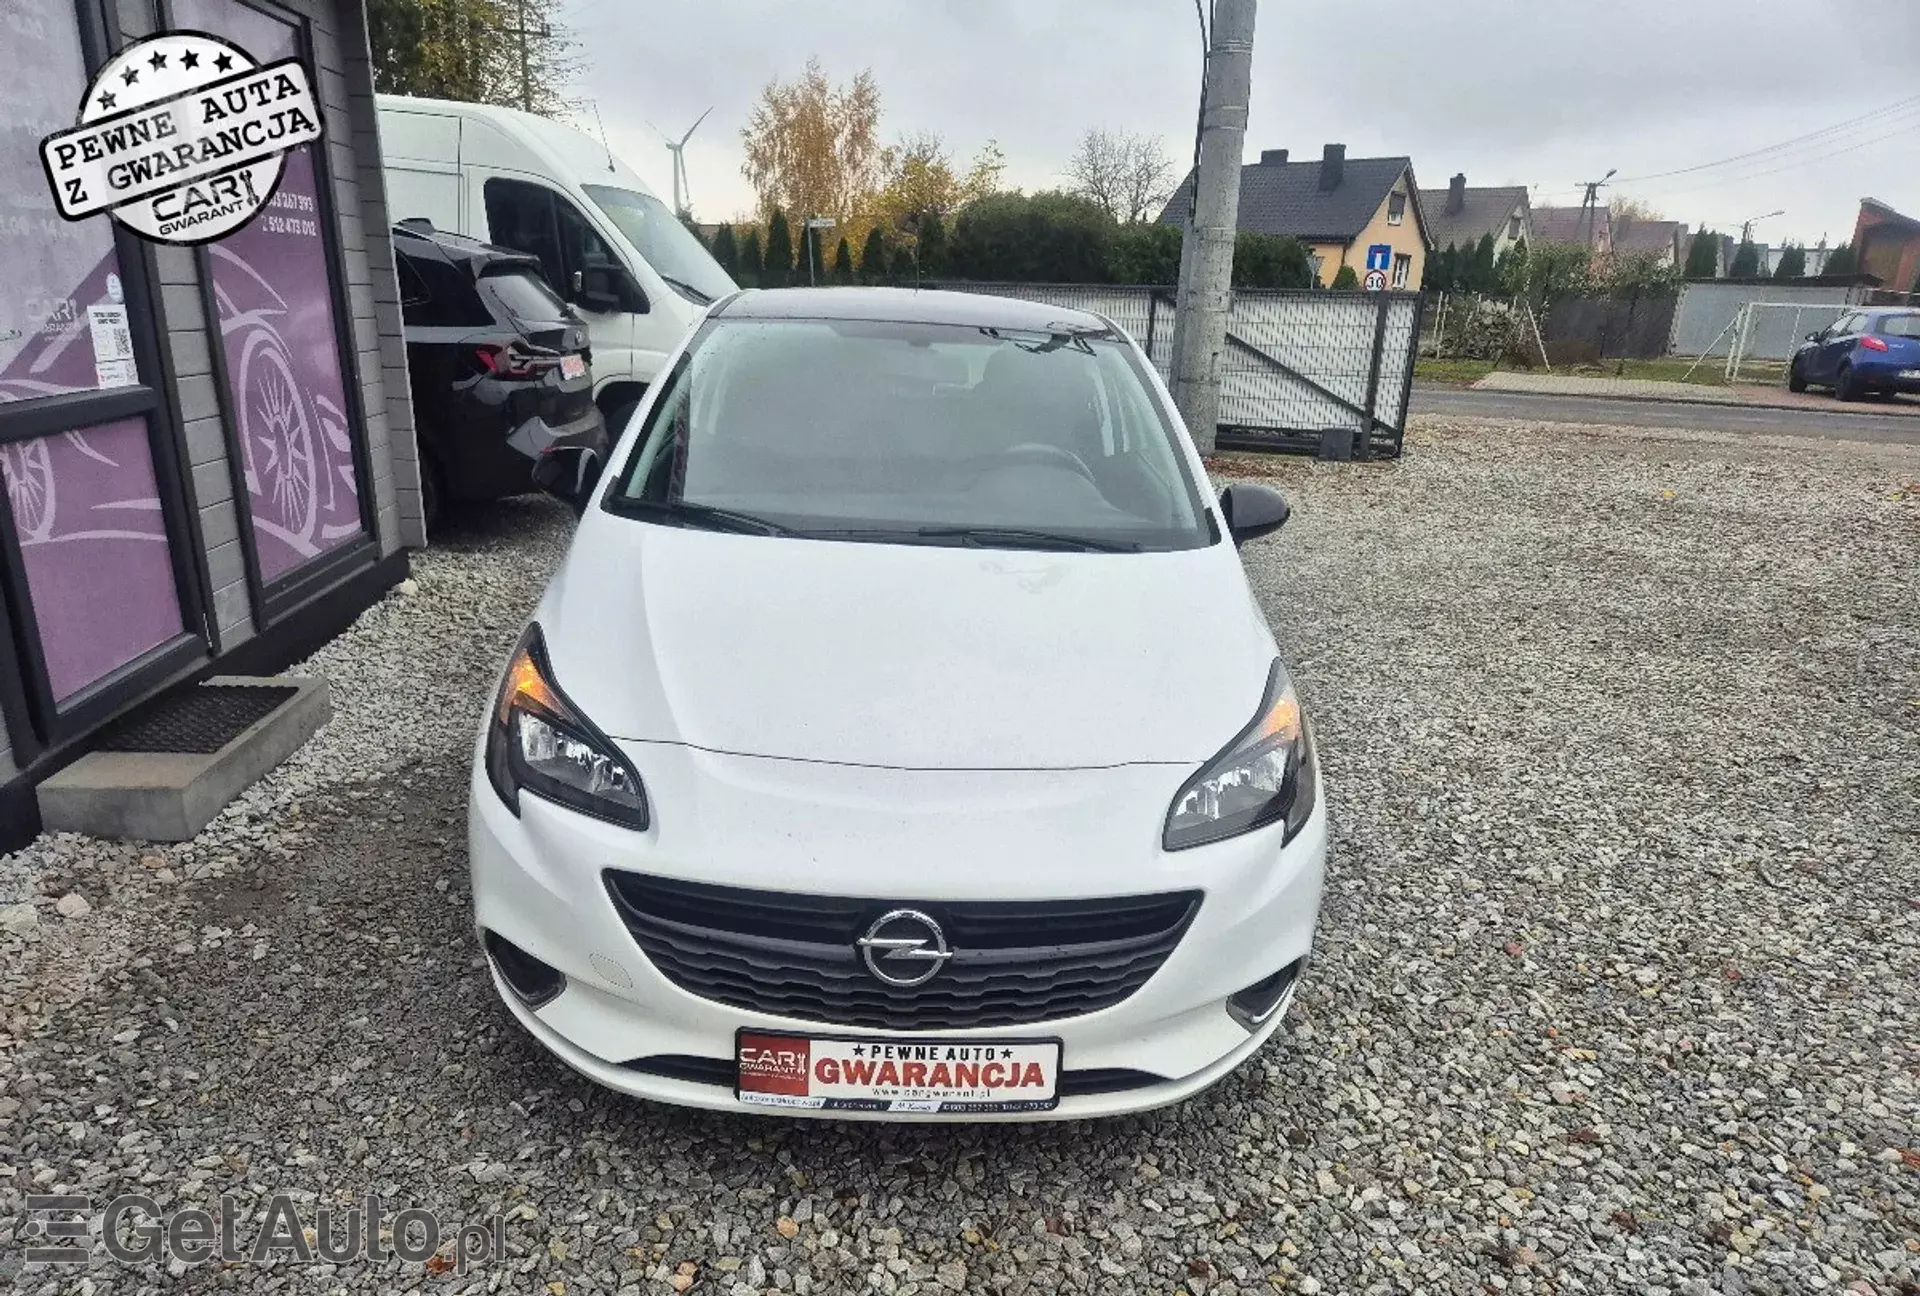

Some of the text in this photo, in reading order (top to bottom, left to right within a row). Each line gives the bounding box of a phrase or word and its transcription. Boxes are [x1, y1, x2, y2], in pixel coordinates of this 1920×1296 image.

[268, 191, 281, 208] 03
[269, 216, 285, 233] 512
[302, 220, 317, 237] 012
[1368, 276, 1384, 289] 30
[740, 1047, 796, 1067] CAR
[871, 1045, 996, 1061] PEWNE AUTO
[814, 1057, 1045, 1088] GWARANCJA
